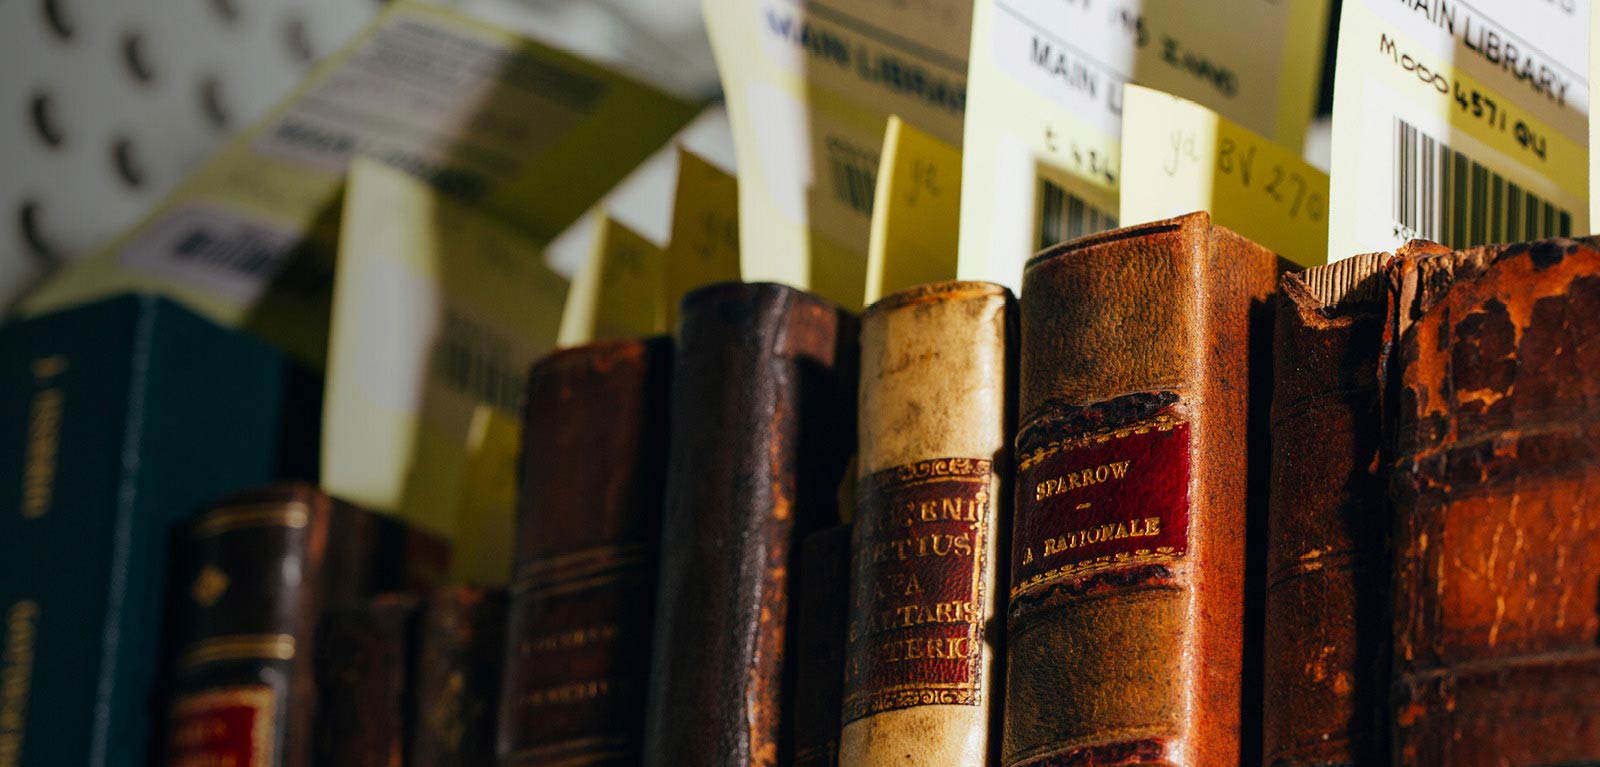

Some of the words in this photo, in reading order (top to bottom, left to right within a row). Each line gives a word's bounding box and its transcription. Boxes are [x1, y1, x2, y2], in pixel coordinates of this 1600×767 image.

[1031, 36, 1097, 98] MAIN
[1401, 0, 1455, 36] AIN
[1463, 16, 1570, 109] LIBRARY
[1036, 459, 1132, 502] SPARROW
[1043, 516, 1161, 558] RATIONALE
